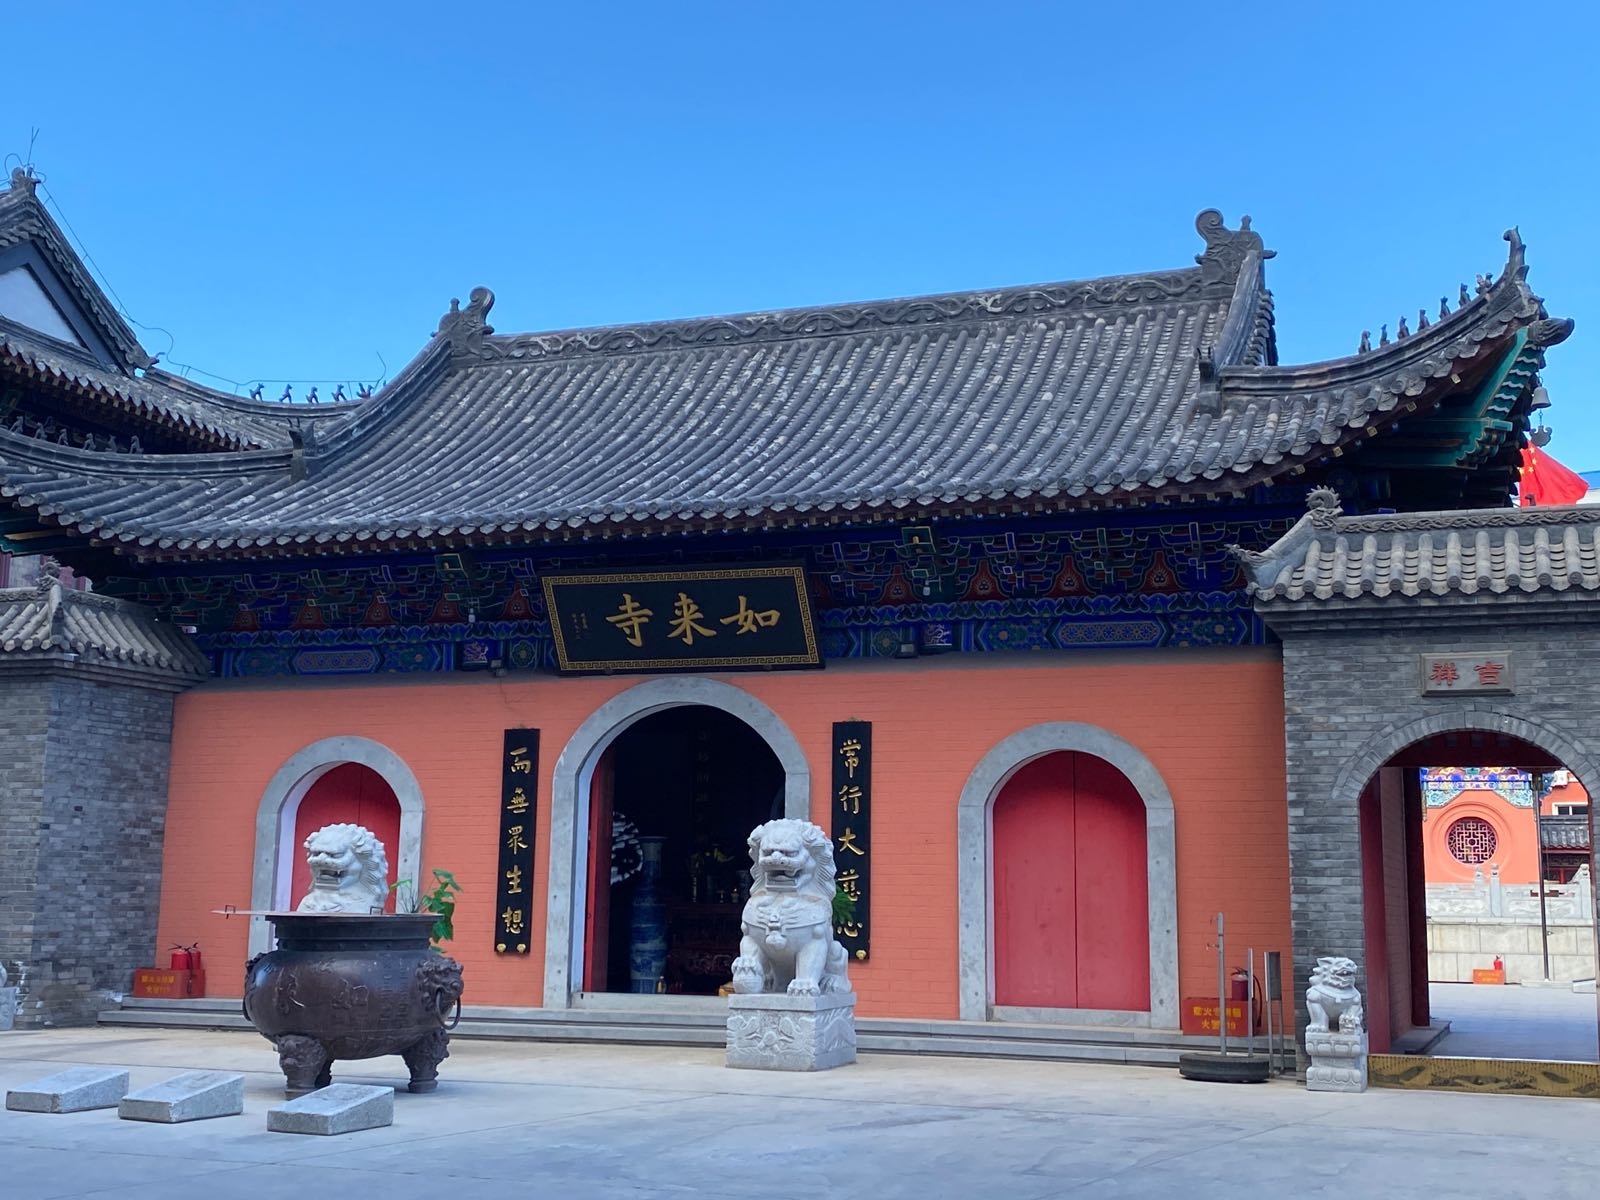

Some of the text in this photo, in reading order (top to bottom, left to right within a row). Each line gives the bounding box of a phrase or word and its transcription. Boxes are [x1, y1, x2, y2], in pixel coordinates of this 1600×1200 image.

[606, 593, 781, 647] 如来寺
[1430, 661, 1504, 686] 吉祥
[838, 739, 865, 937] 常行大慈心
